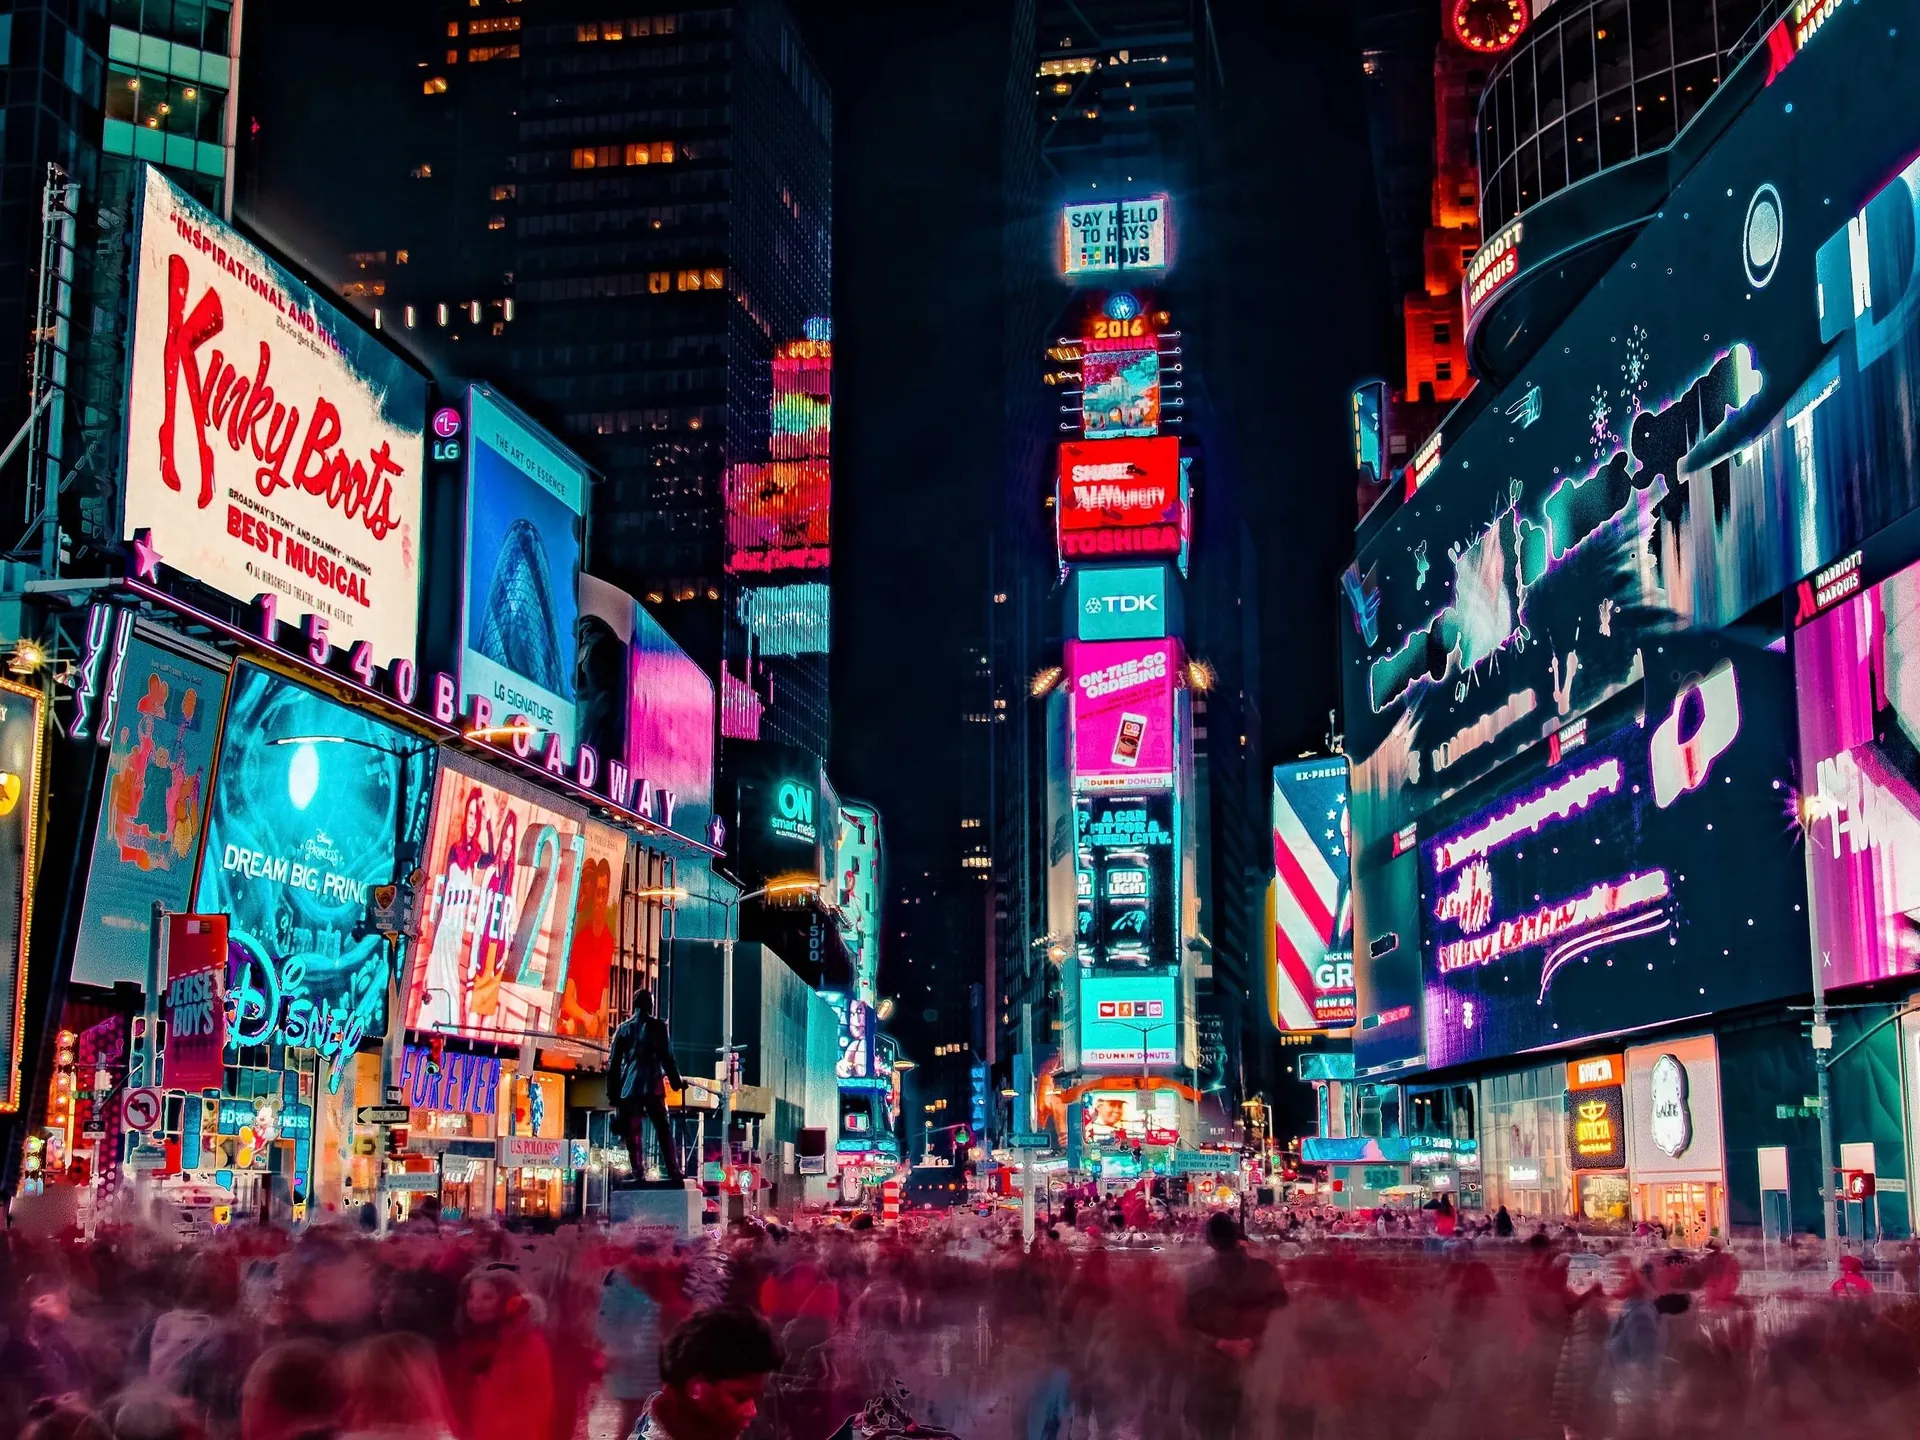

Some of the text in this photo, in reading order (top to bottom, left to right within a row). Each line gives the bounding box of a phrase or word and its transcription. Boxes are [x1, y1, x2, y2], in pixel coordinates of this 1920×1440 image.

[1072, 207, 1158, 228] SAY HELLO
[1081, 224, 1150, 243] TO HAYS
[1469, 222, 1523, 287] MARRIOTT
[1470, 253, 1515, 309] MARQUIS
[288, 303, 314, 333] AND
[1095, 319, 1144, 339] 2016
[1083, 334, 1157, 352] TOSHIBA
[159, 254, 405, 541] Kinky Boots
[434, 442, 460, 460] LG
[496, 433, 566, 496] THE ART OF ESSENCE
[297, 527, 311, 541] AND
[1062, 526, 1179, 555] TOSHIBA
[227, 504, 370, 608] BEST MUSICAL
[1816, 550, 1862, 589] MARRIOTT
[1817, 573, 1859, 607] MARQUIS
[1101, 594, 1158, 613] TDK
[1079, 651, 1167, 688] ON-THE-GO
[1086, 664, 1167, 699] ORDERING
[494, 680, 554, 726] LG SIGNATURE
[434, 671, 677, 828] BROADWAY
[1127, 776, 1163, 785] DONUTS
[778, 784, 813, 823] ON
[772, 817, 797, 832] smart
[1101, 810, 1147, 822] A CAN
[1115, 821, 1146, 834] FOR
[1147, 820, 1160, 832] A
[1131, 831, 1172, 844] CITY.
[223, 843, 368, 905] DREAM BIG, PRINC
[1111, 871, 1143, 883] BUD
[1108, 882, 1146, 895] LIGHT
[516, 823, 585, 993] 21
[1315, 963, 1354, 988] GR
[1315, 997, 1338, 1008] NEW
[173, 1002, 215, 1037] BOYS
[1137, 1051, 1170, 1059] DONUTS
[400, 1045, 502, 1115] FOREVER
[372, 1111, 405, 1120] ONE WAY
[510, 1139, 523, 1154] U.S.
[524, 1140, 542, 1155] POLO
[1364, 1168, 1399, 1189] 1515
